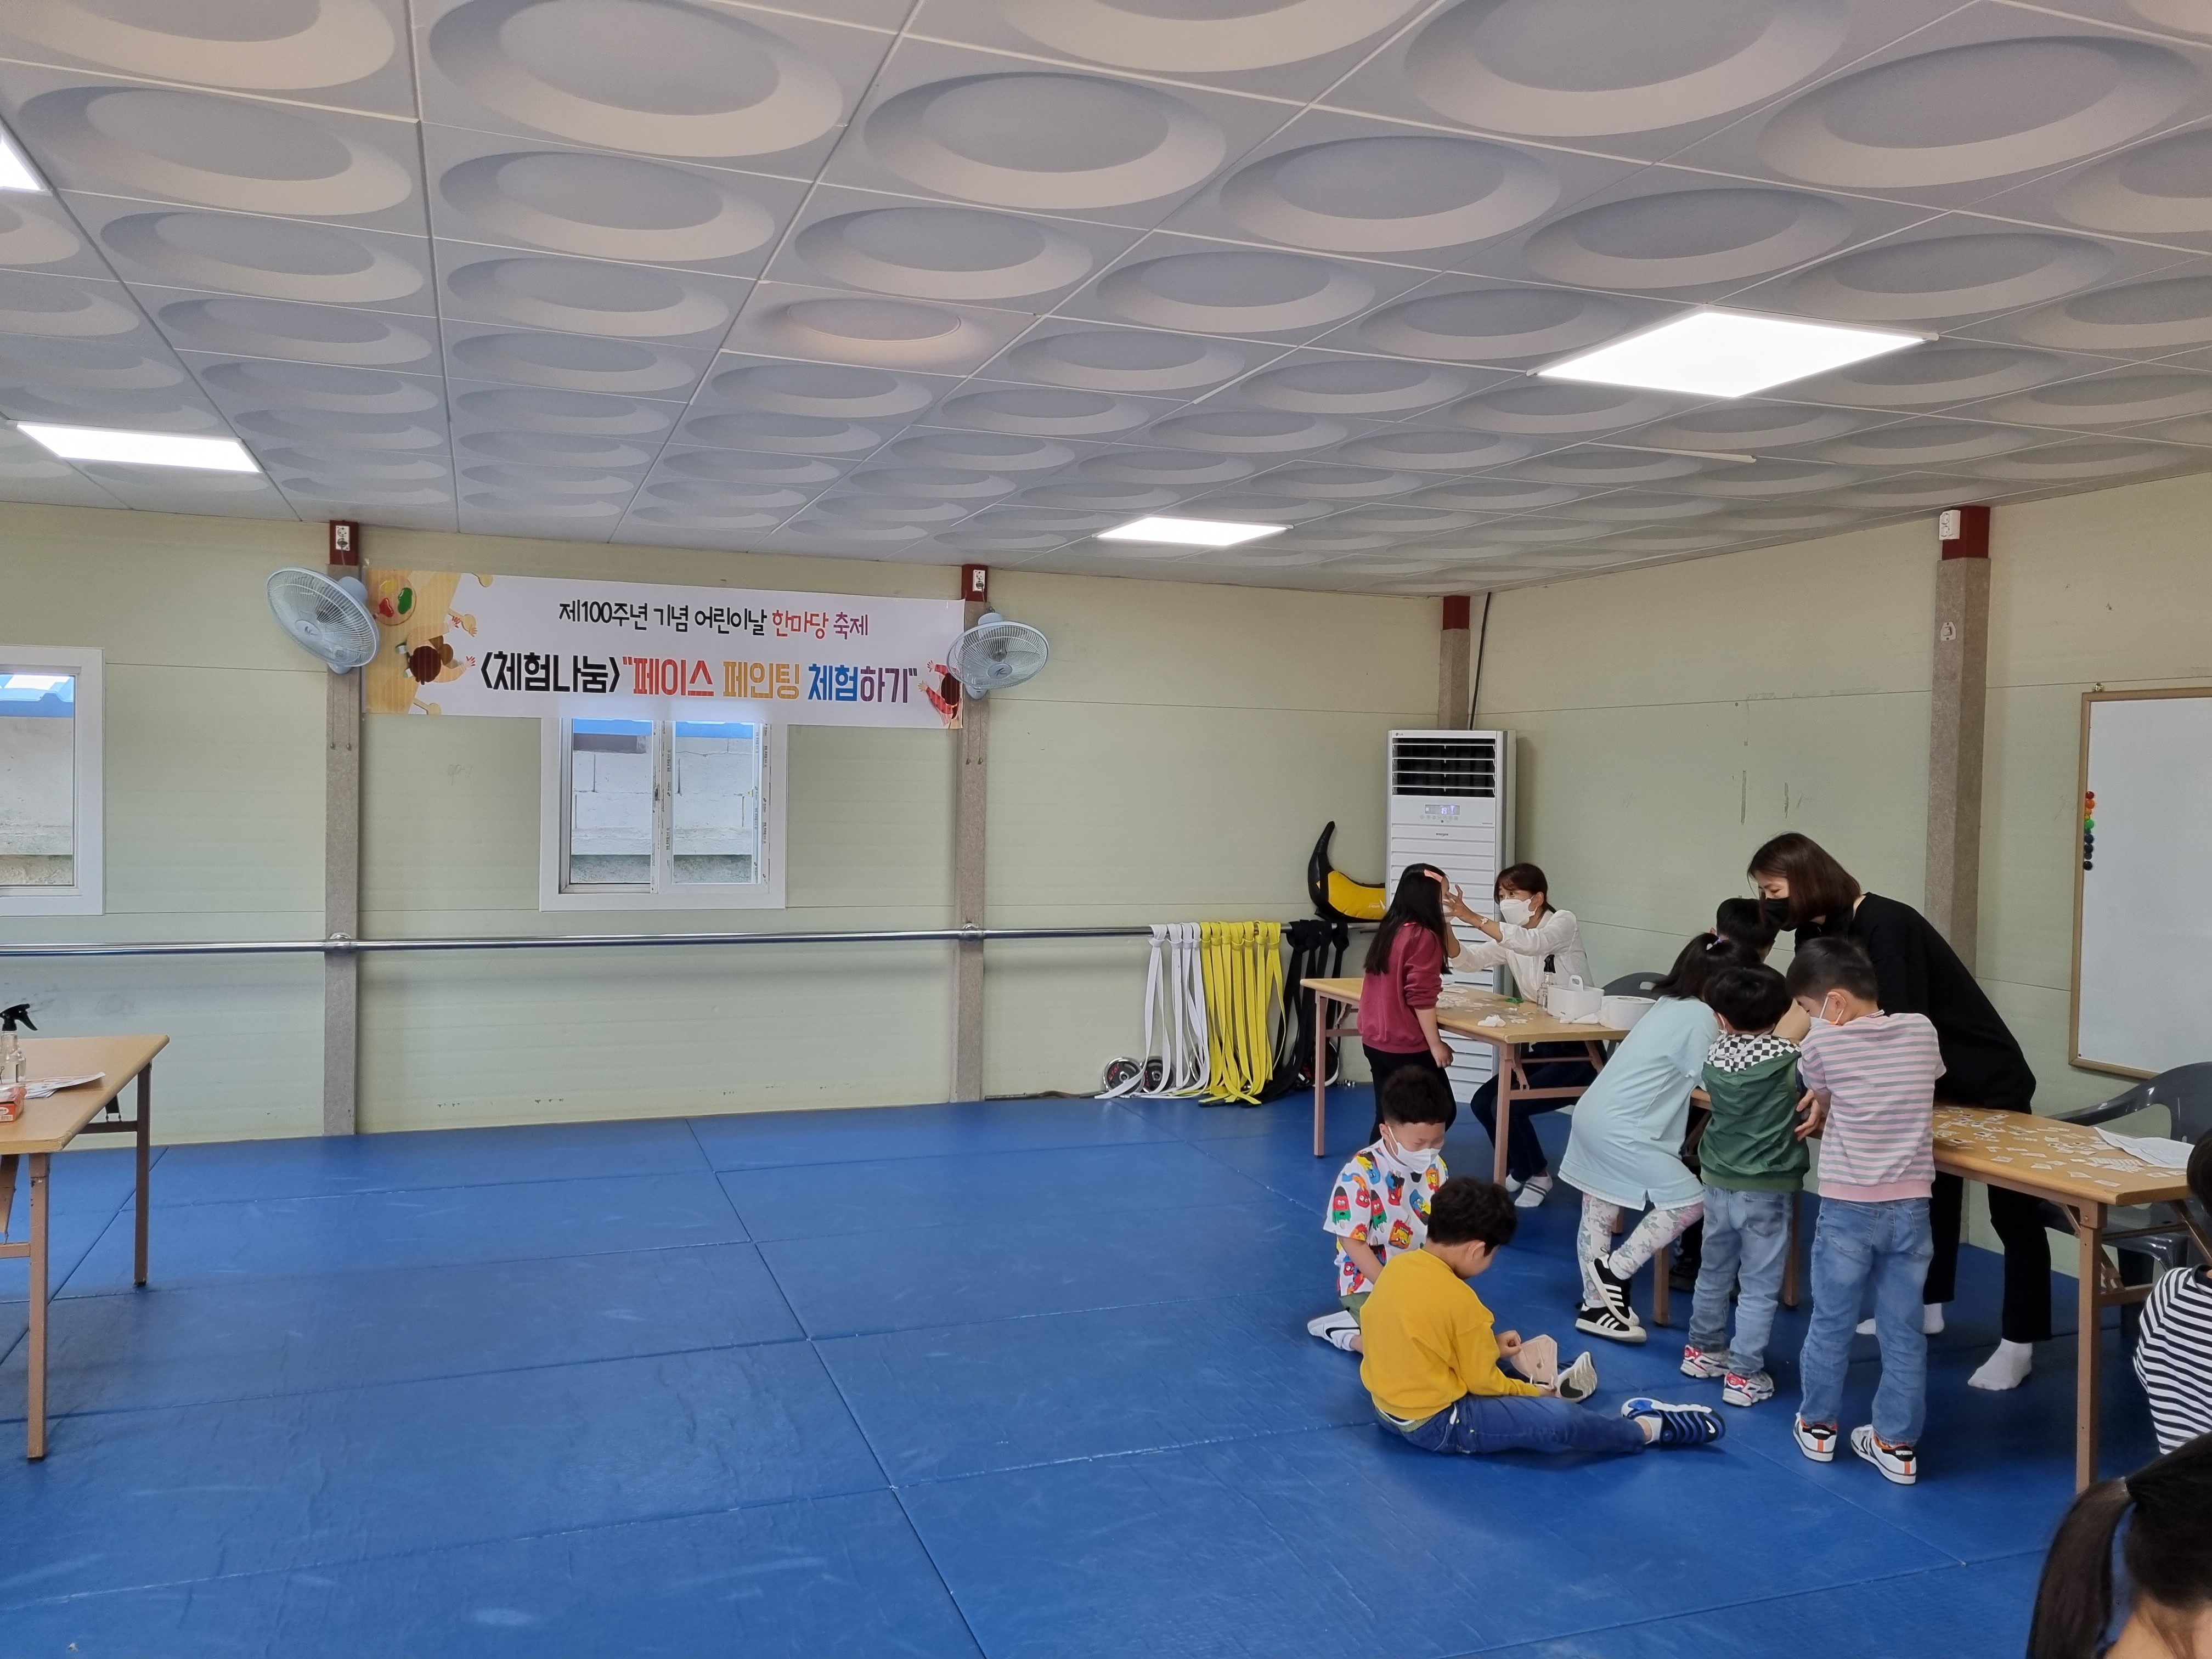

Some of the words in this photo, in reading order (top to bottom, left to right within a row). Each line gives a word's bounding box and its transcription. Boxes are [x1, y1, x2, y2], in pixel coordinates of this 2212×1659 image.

[558, 599, 648, 630] 제100주년
[653, 604, 689, 633] 기념
[694, 606, 768, 636] 어린이날
[772, 609, 829, 639] 한마당
[833, 611, 868, 640] 축제
[723, 661, 800, 699] 페인팅
[808, 663, 918, 703] 체험하기"
